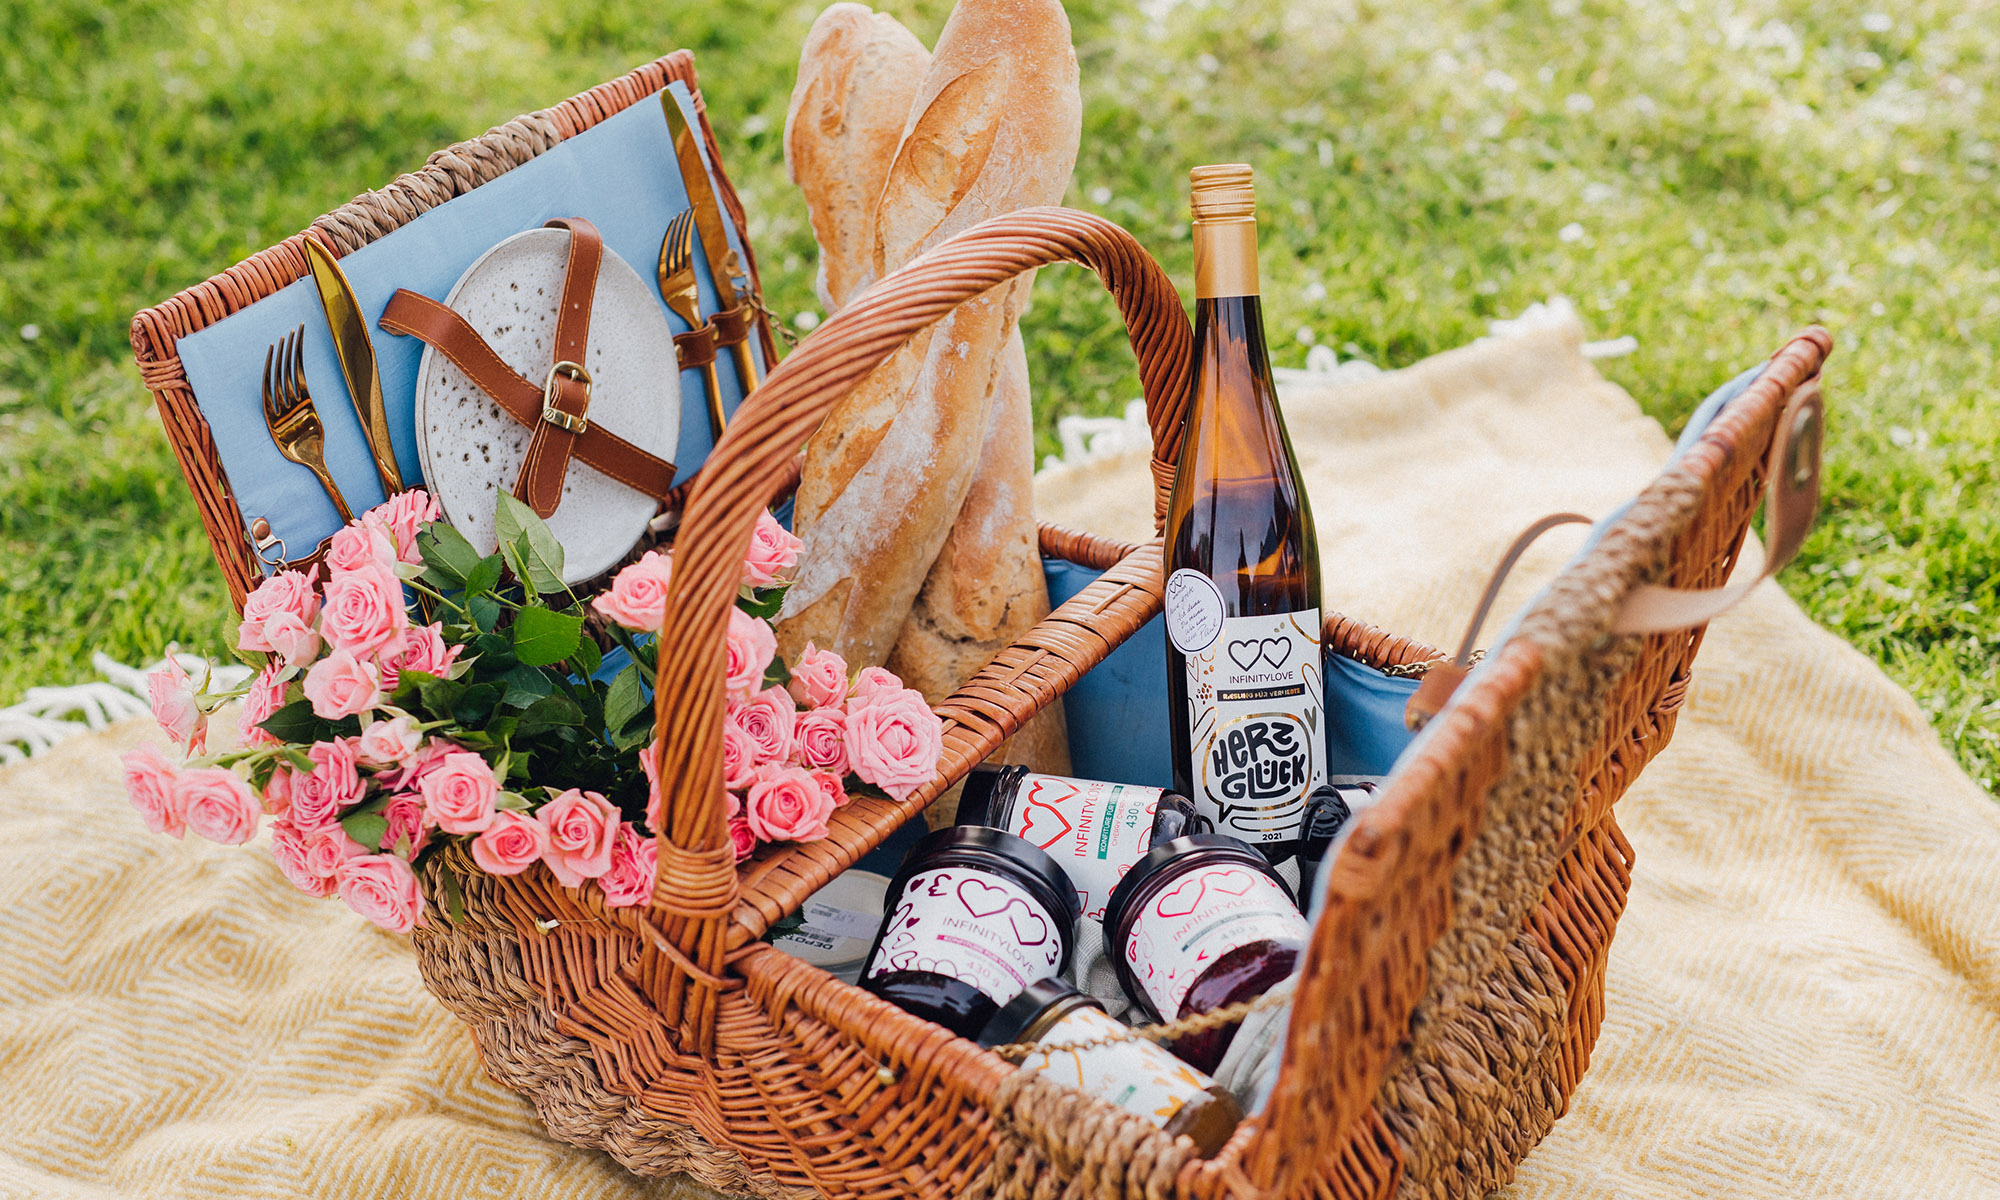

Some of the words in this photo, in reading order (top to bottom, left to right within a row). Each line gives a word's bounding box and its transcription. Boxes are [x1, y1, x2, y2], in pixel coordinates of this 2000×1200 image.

[1229, 671, 1294, 684] INFINITYLOVE
[1221, 753, 1306, 799] GLÜCK
[1074, 783, 1104, 857] INFINITYLOVE
[1126, 808, 1139, 828] 430
[1262, 832, 1282, 840] 2021
[942, 917, 1035, 977] INFINITYLOVE
